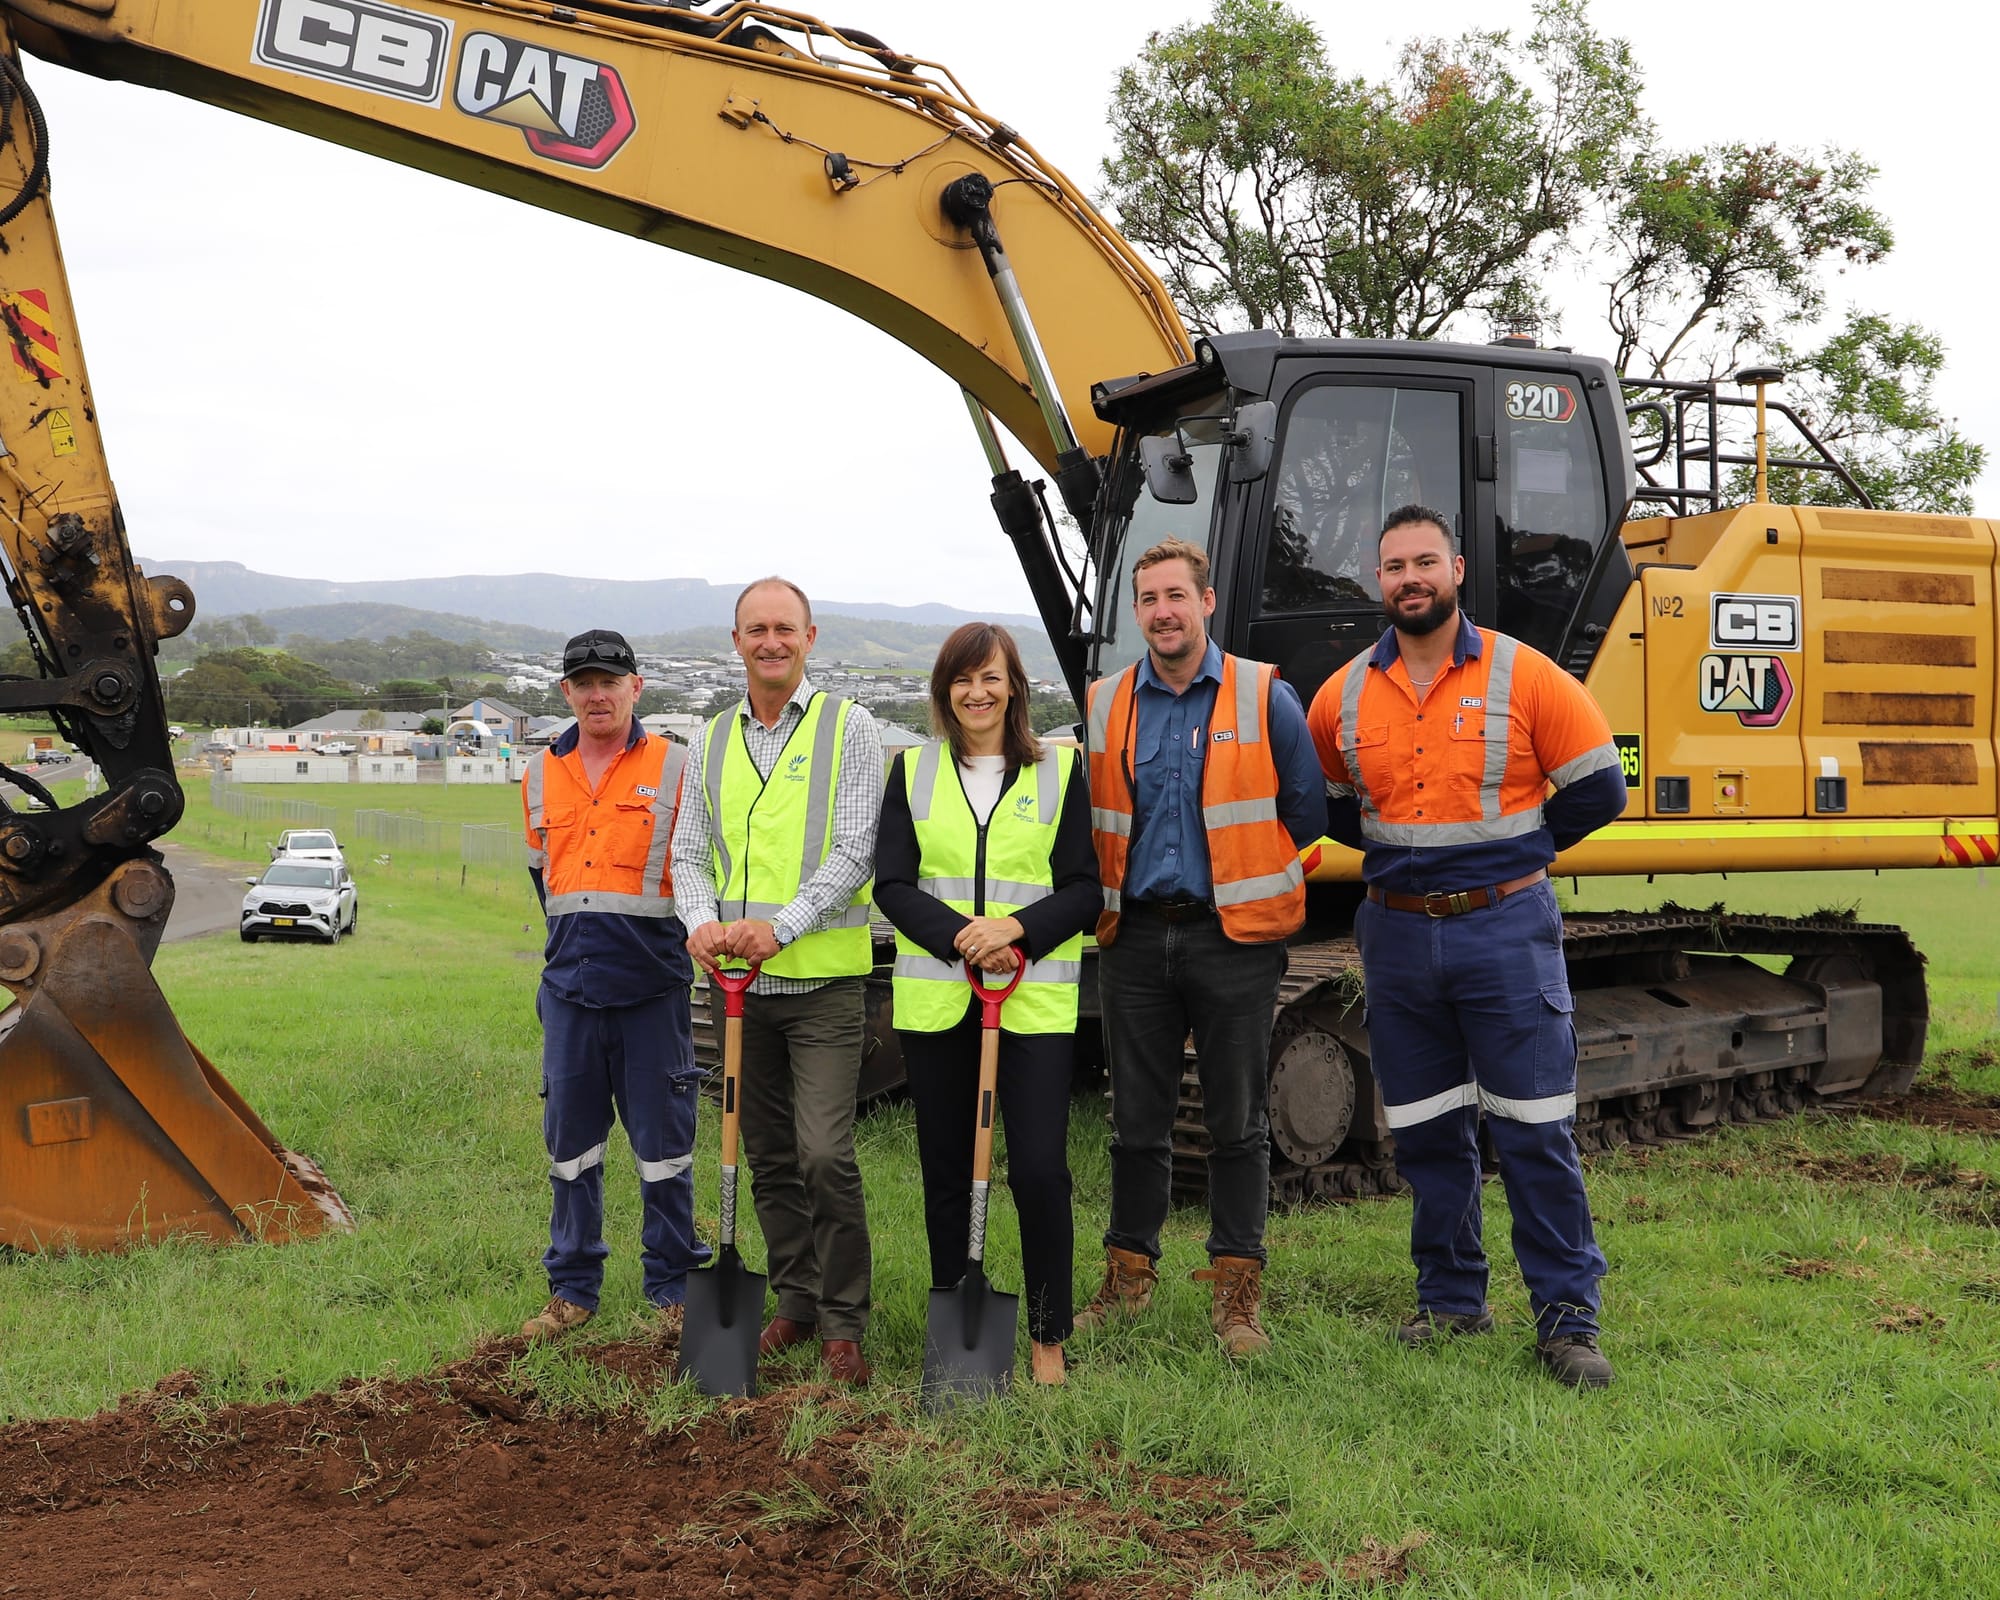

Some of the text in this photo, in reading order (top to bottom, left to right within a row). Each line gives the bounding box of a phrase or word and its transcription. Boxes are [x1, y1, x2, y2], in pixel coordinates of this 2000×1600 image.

[274, 0, 433, 87] CB
[457, 33, 599, 138] CAT
[1508, 383, 1559, 419] 320
[1718, 603, 1793, 642] CB
[1701, 655, 1771, 711] CAT
[1616, 746, 1639, 776] 65
